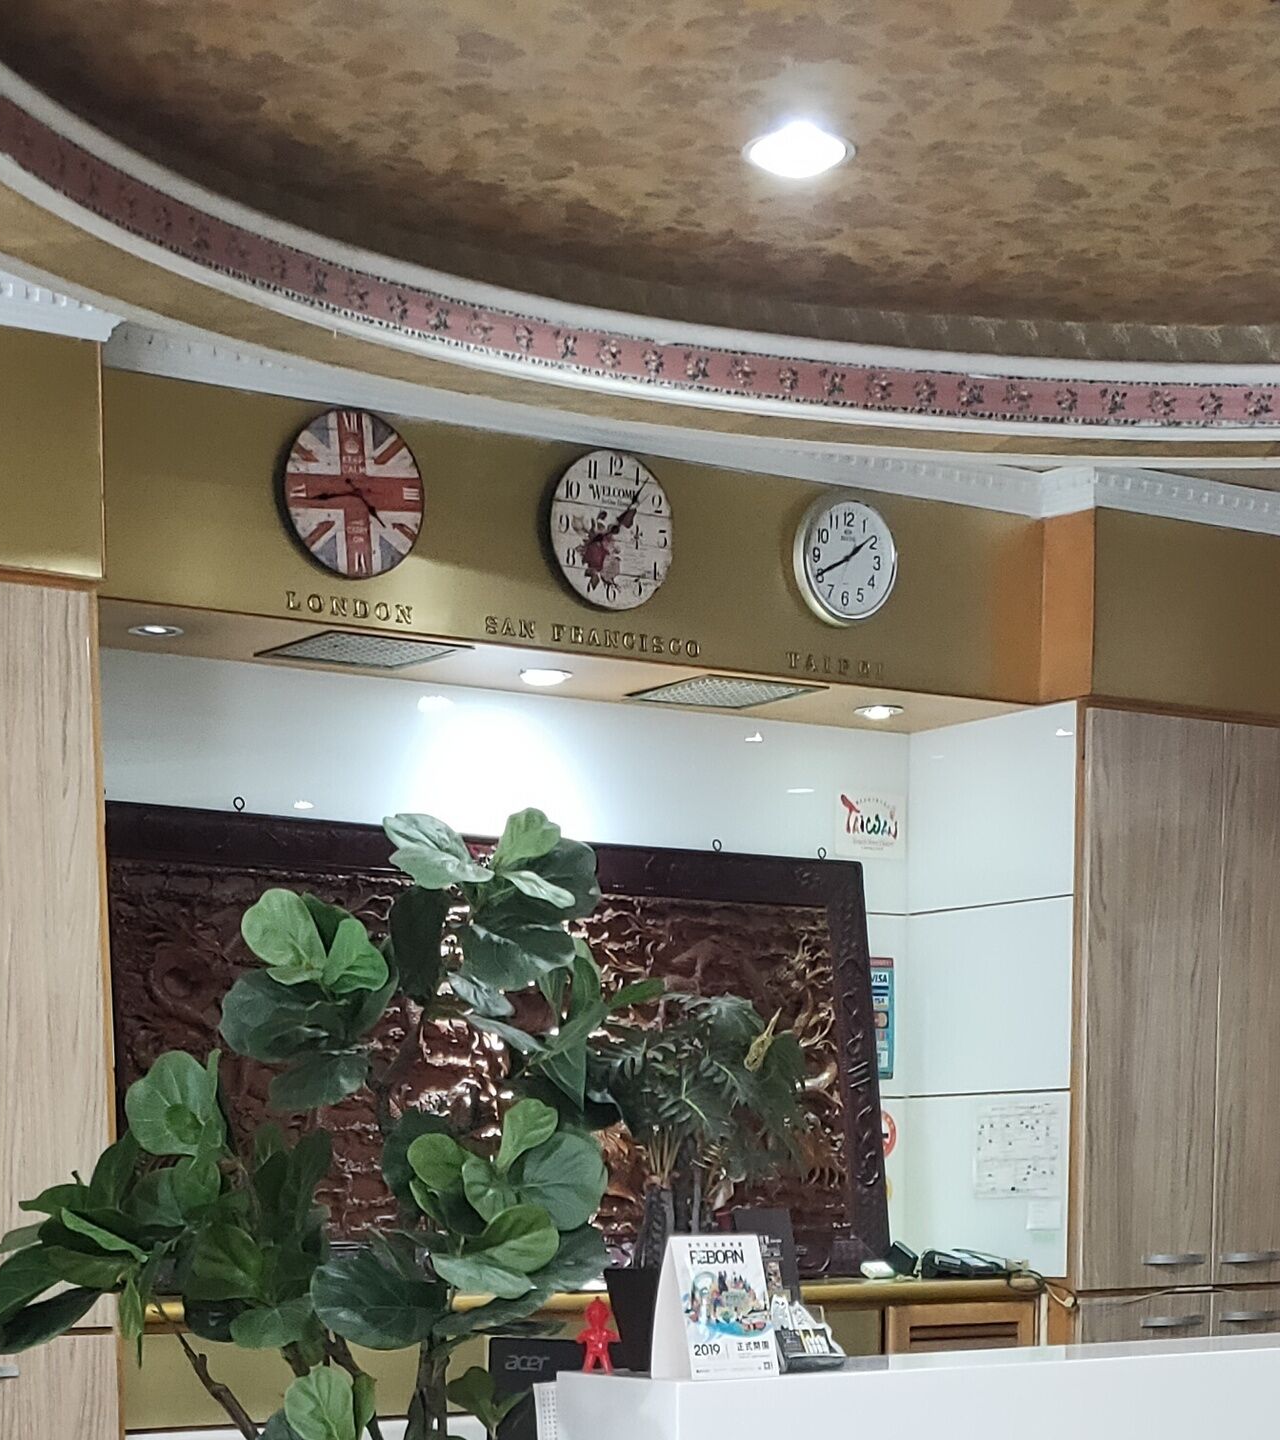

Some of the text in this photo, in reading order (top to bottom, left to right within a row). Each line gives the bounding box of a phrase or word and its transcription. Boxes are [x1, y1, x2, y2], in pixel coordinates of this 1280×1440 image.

[342, 465, 366, 474] CALM
[588, 460, 598, 479] 11
[609, 456, 624, 476] 12
[635, 467, 640, 486] 1
[564, 479, 580, 500] 10
[651, 495, 663, 514] 2
[558, 515, 570, 534] 9
[829, 513, 839, 530] 11
[843, 512, 855, 528] 12
[862, 519, 867, 534] 1
[817, 528, 829, 544] 10
[869, 535, 877, 550] 2
[566, 548, 576, 566] 8
[813, 547, 821, 563] 9
[873, 555, 881, 571] 3
[816, 569, 824, 584] 8
[868, 575, 875, 590] 4
[606, 584, 617, 602] 6
[827, 584, 835, 599] 7
[841, 591, 849, 606] 6
[856, 588, 864, 603] 5
[286, 591, 412, 624] LONDON
[485, 615, 702, 658] SAN FRANCISCO
[689, 1249, 745, 1265] REBORN
[693, 1343, 721, 1357] 2019
[504, 1354, 550, 1371] acer
